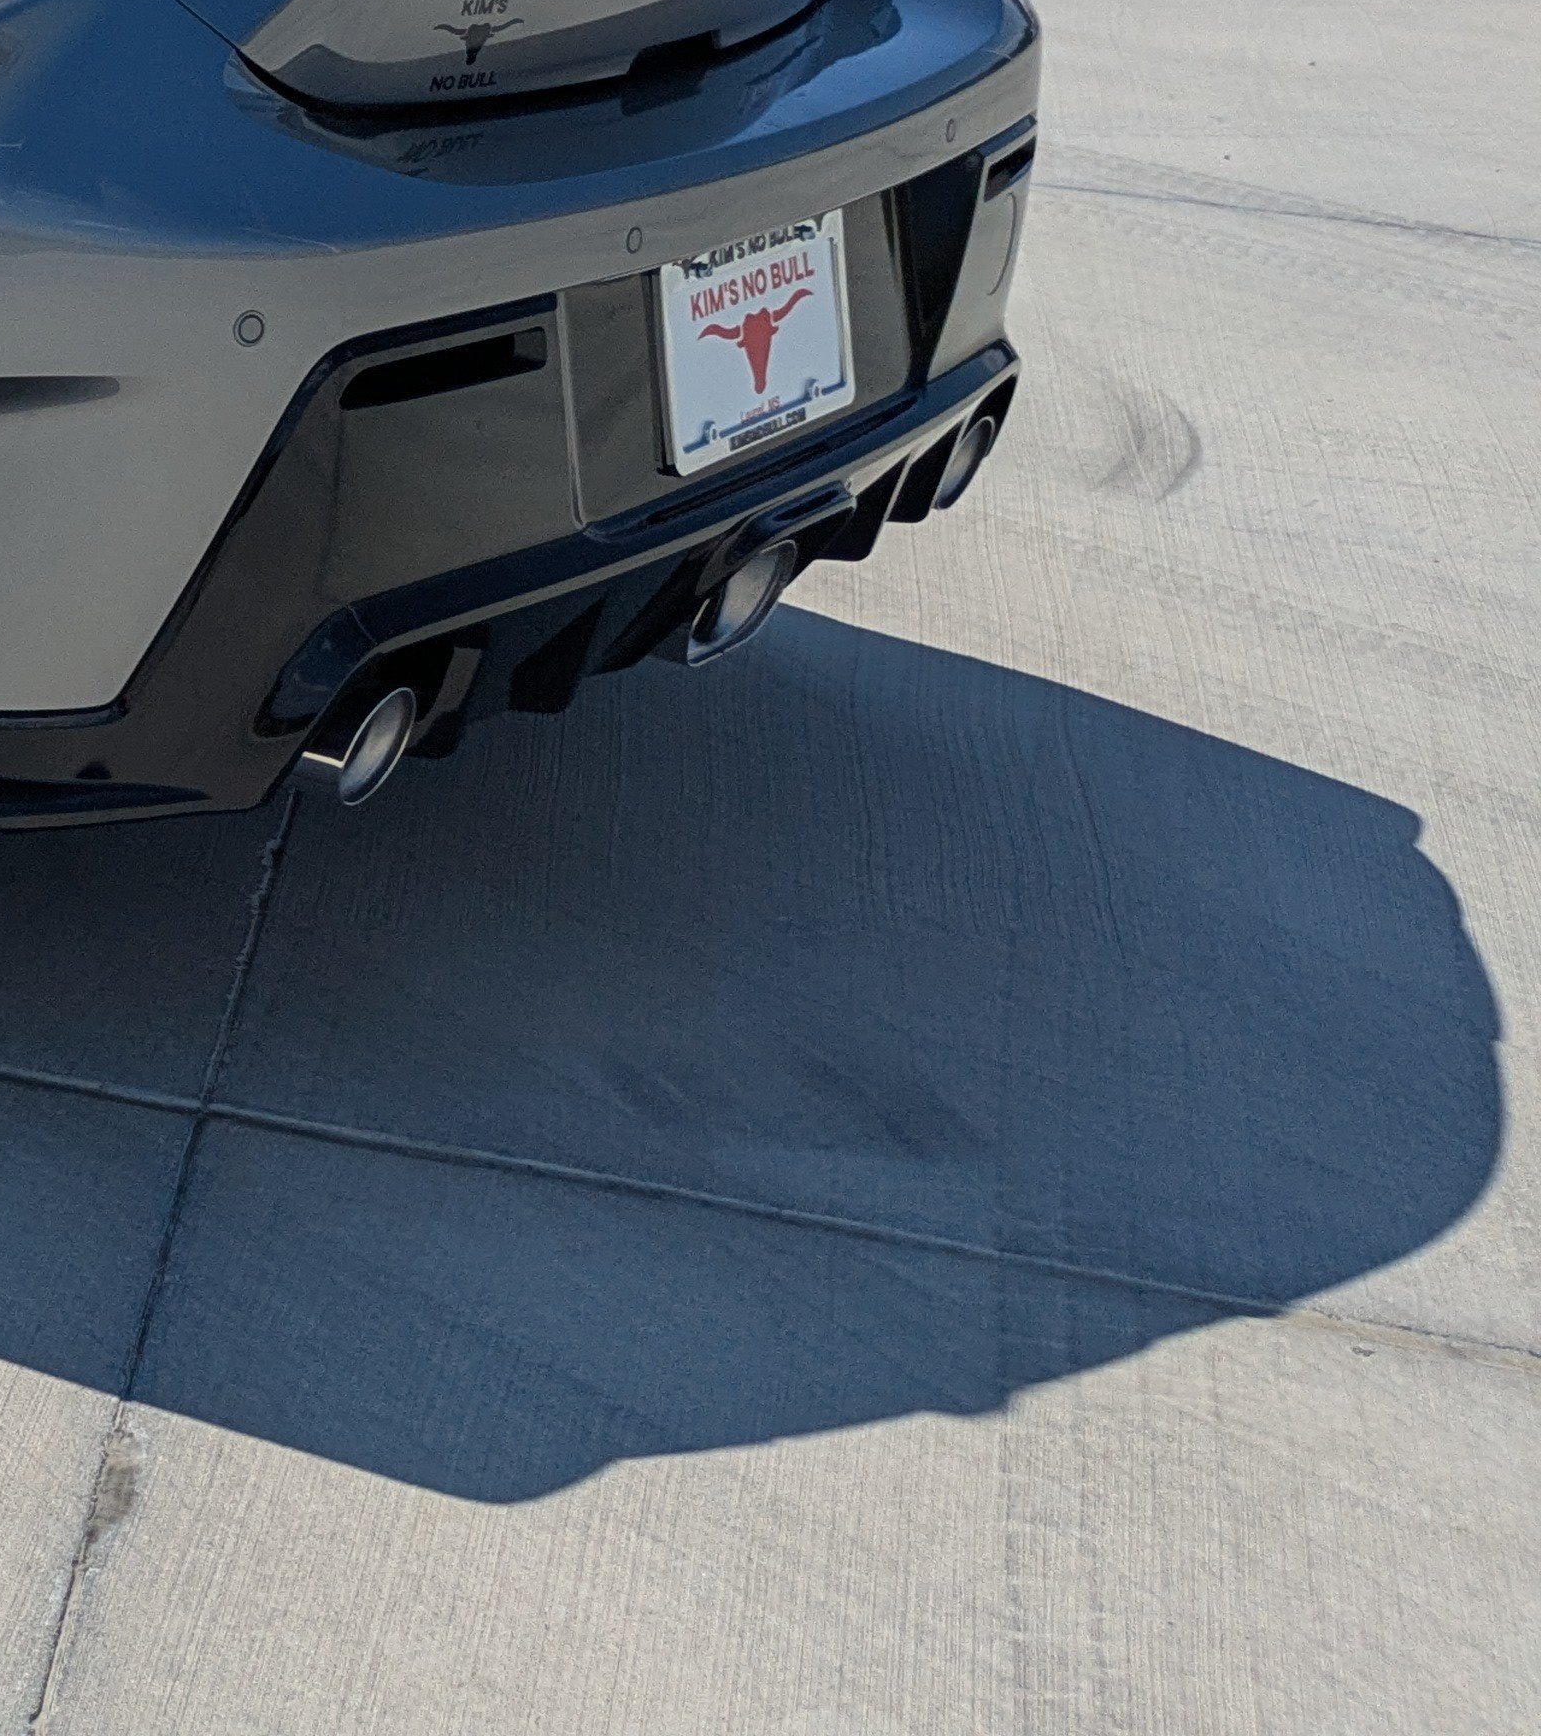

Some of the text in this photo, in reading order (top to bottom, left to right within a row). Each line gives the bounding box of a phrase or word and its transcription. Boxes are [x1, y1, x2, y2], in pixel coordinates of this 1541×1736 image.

[429, 70, 496, 92] NO BULL
[709, 241, 745, 267] KIMS
[690, 252, 815, 321] KIM'S NO BULL
